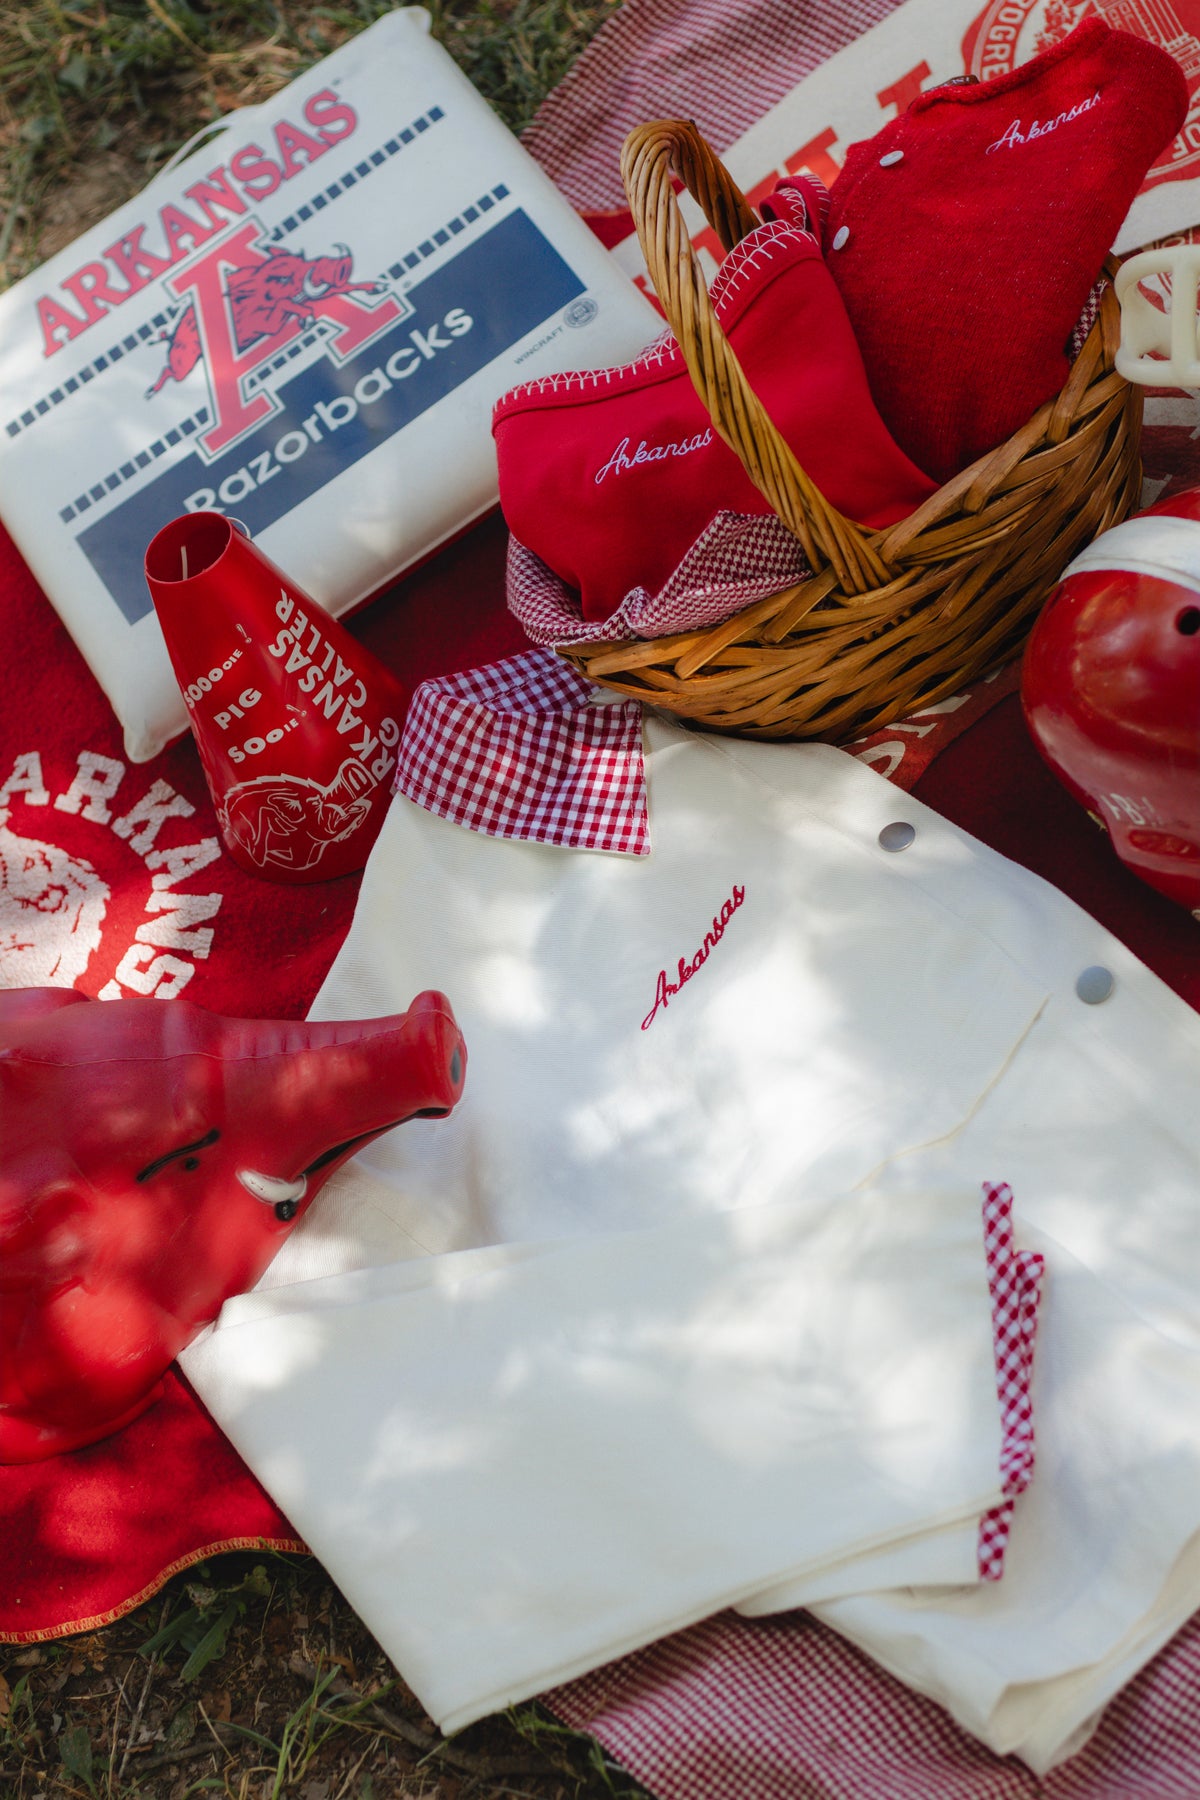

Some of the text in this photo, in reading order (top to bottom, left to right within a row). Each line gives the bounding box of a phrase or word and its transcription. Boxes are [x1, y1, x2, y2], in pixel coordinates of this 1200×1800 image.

[985, 89, 1103, 155] Arkansas
[34, 88, 359, 358] ARKANSAS
[183, 305, 474, 514] Razorbacks
[513, 325, 564, 366] WINCRAFT
[594, 427, 713, 485] Arkansas
[213, 687, 263, 731] PIG
[268, 628, 400, 797] RKANSAS
[275, 588, 368, 709] CALLER
[0, 750, 224, 1001] ARKANS
[641, 885, 745, 1031] Arkansas
